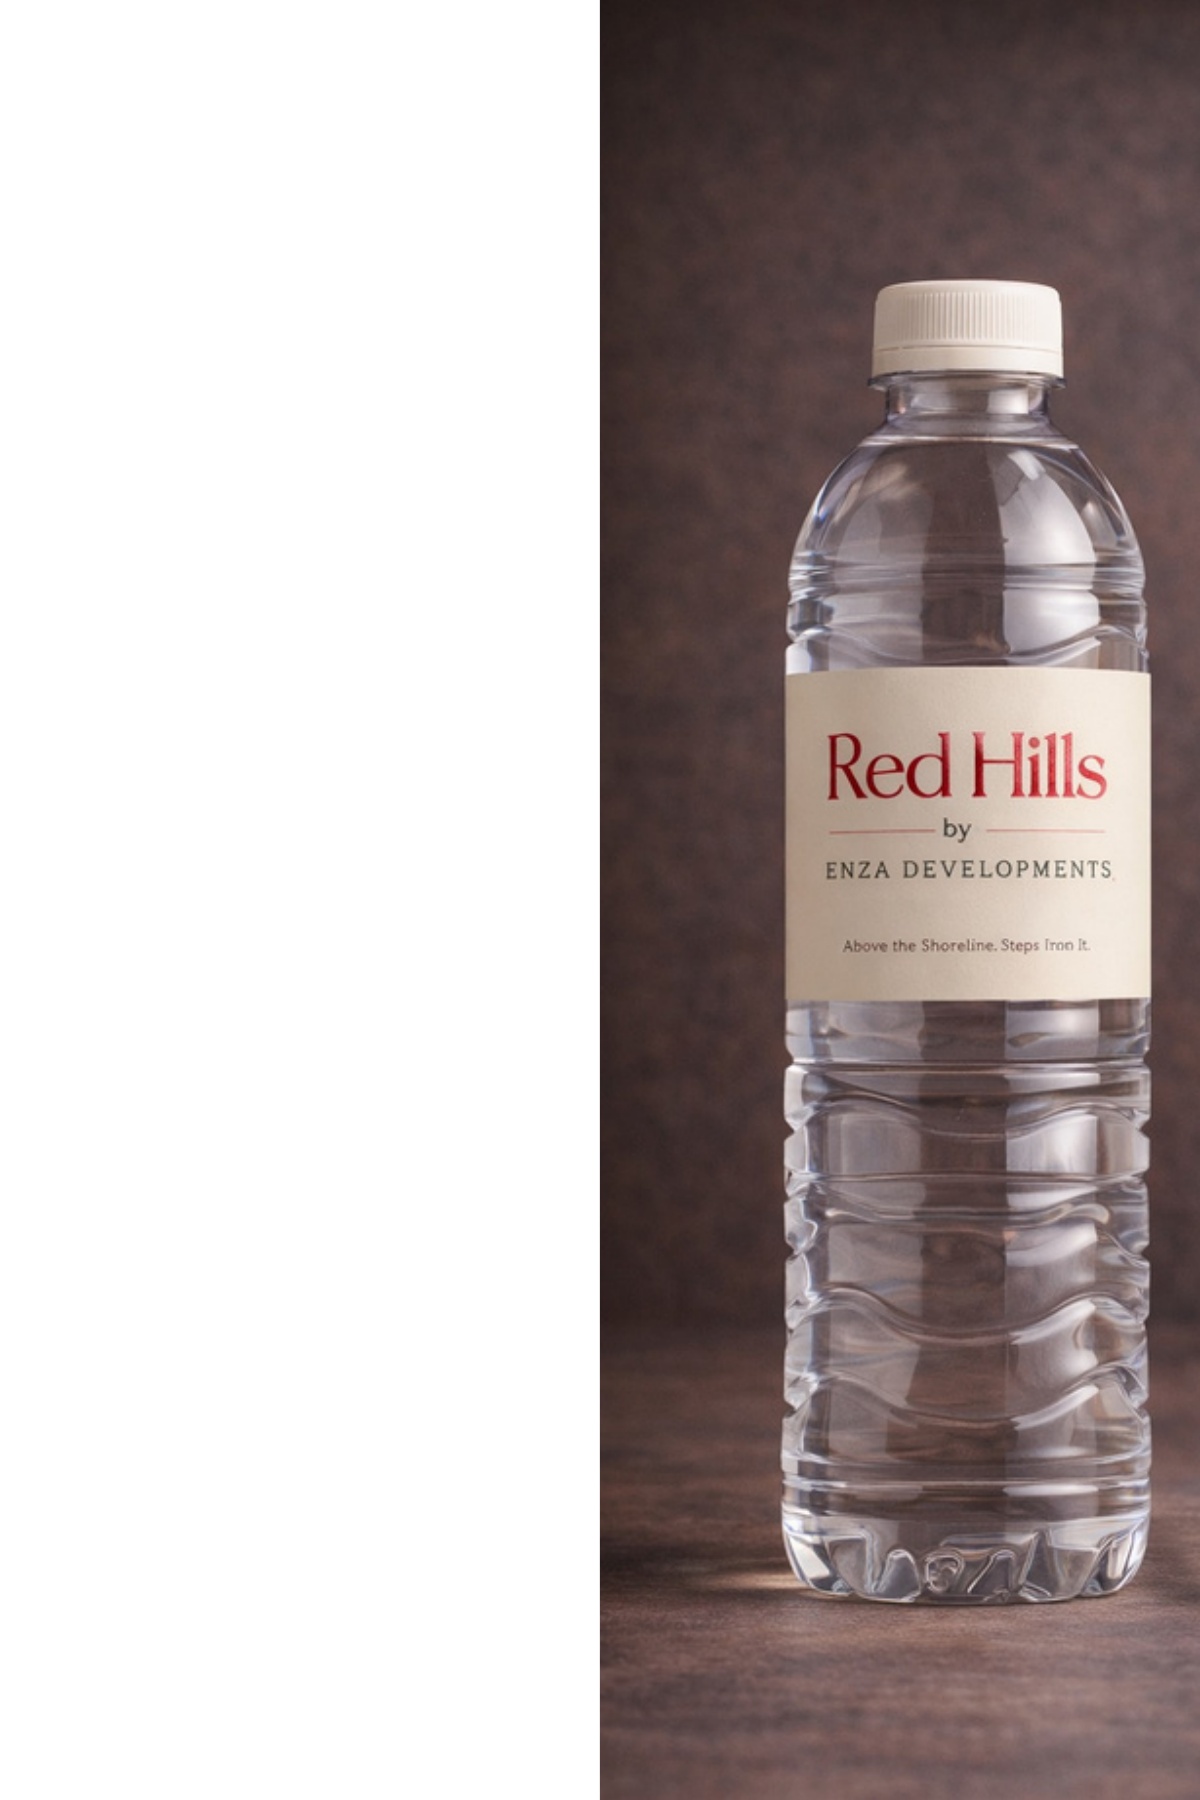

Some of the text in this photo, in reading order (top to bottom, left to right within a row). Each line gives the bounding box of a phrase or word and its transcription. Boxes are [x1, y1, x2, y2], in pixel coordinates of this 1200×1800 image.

[827, 731, 1108, 801] Red Hills
[943, 817, 972, 843] by
[826, 860, 891, 880] ENZA
[842, 939, 889, 953] Above
[892, 939, 917, 953] the
[921, 938, 998, 953] Shoreline.
[1000, 938, 1040, 955] Steps
